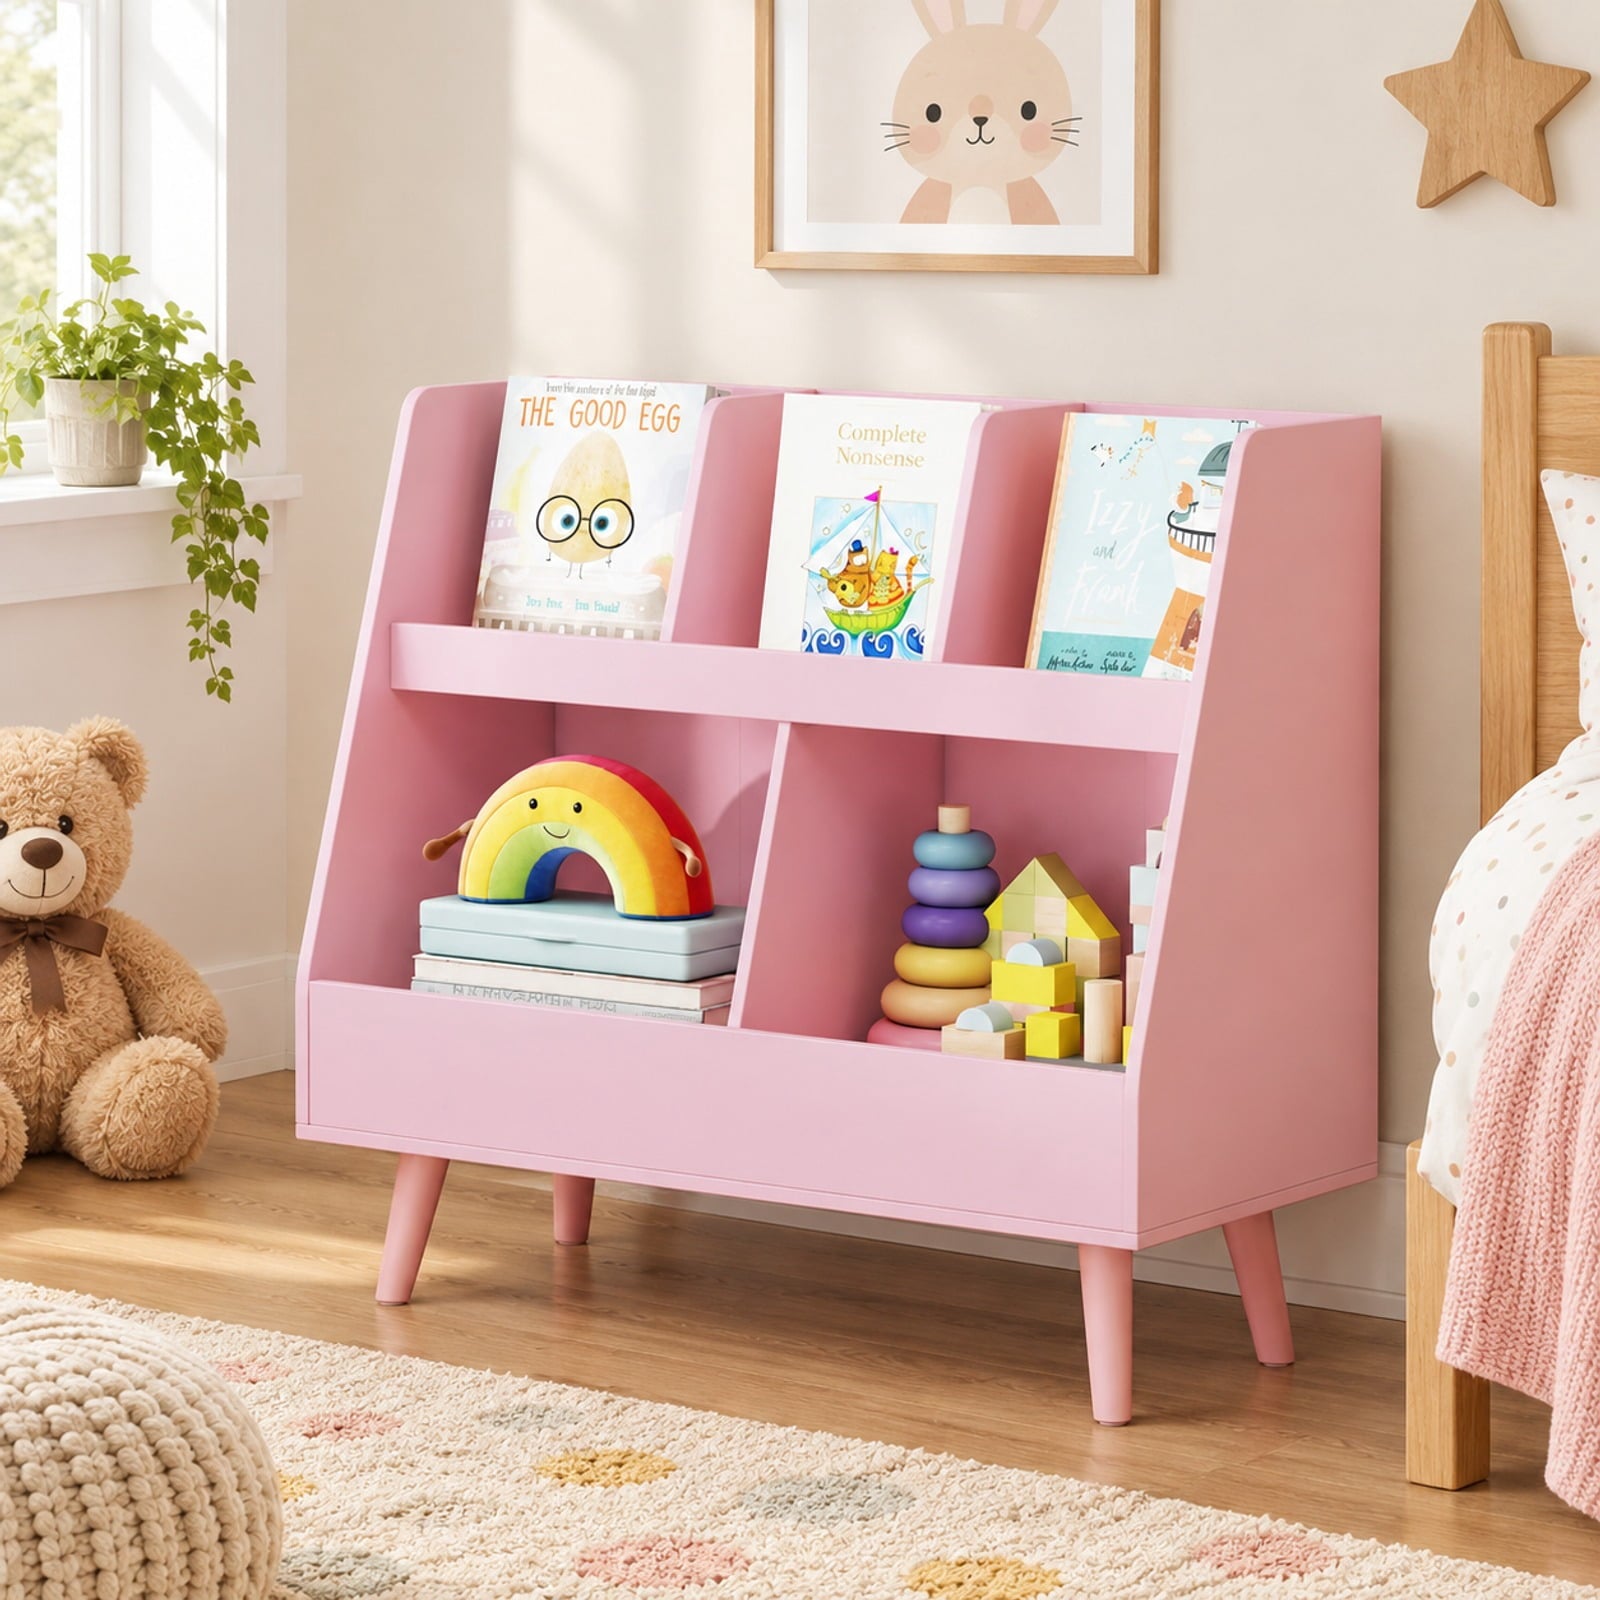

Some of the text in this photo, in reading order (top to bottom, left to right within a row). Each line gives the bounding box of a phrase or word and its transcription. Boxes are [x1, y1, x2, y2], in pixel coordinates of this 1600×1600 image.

[520, 397, 681, 433] THE GOOD EGG
[837, 422, 927, 447] Complete
[835, 446, 925, 468] Nonsense
[1083, 489, 1161, 570] Izzy
[1092, 541, 1118, 560] and
[1064, 562, 1145, 627] Frank
